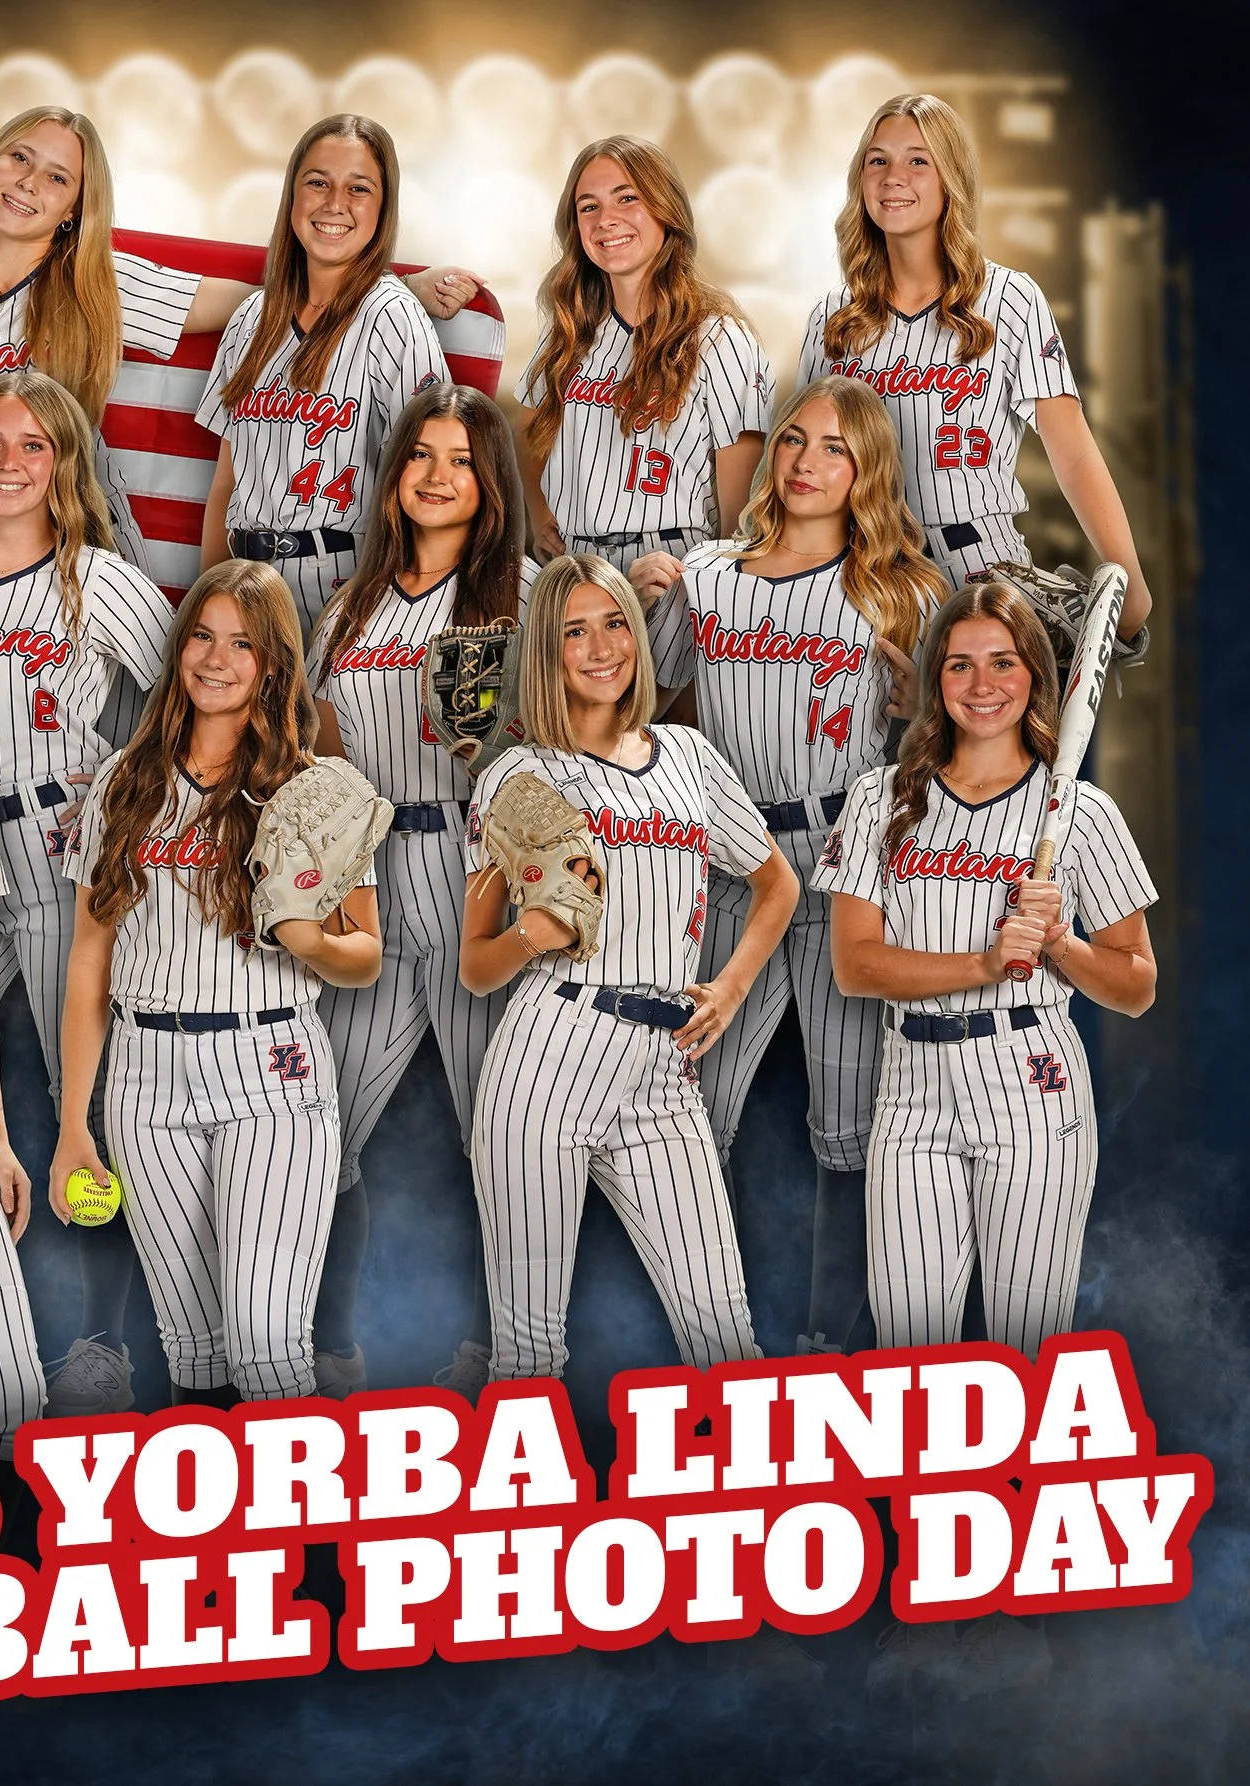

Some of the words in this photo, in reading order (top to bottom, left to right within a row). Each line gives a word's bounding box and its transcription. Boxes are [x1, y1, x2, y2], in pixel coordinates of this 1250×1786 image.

[624, 444, 674, 497] 13
[934, 423, 992, 471] 23
[289, 459, 359, 514] 44
[689, 608, 865, 688] Mustangs
[1087, 575, 1127, 716] EASTON
[805, 696, 854, 752] 14
[269, 1043, 310, 1081] YL
[1027, 1053, 1067, 1093] YL
[1059, 1120, 1081, 1137] LEGENDS
